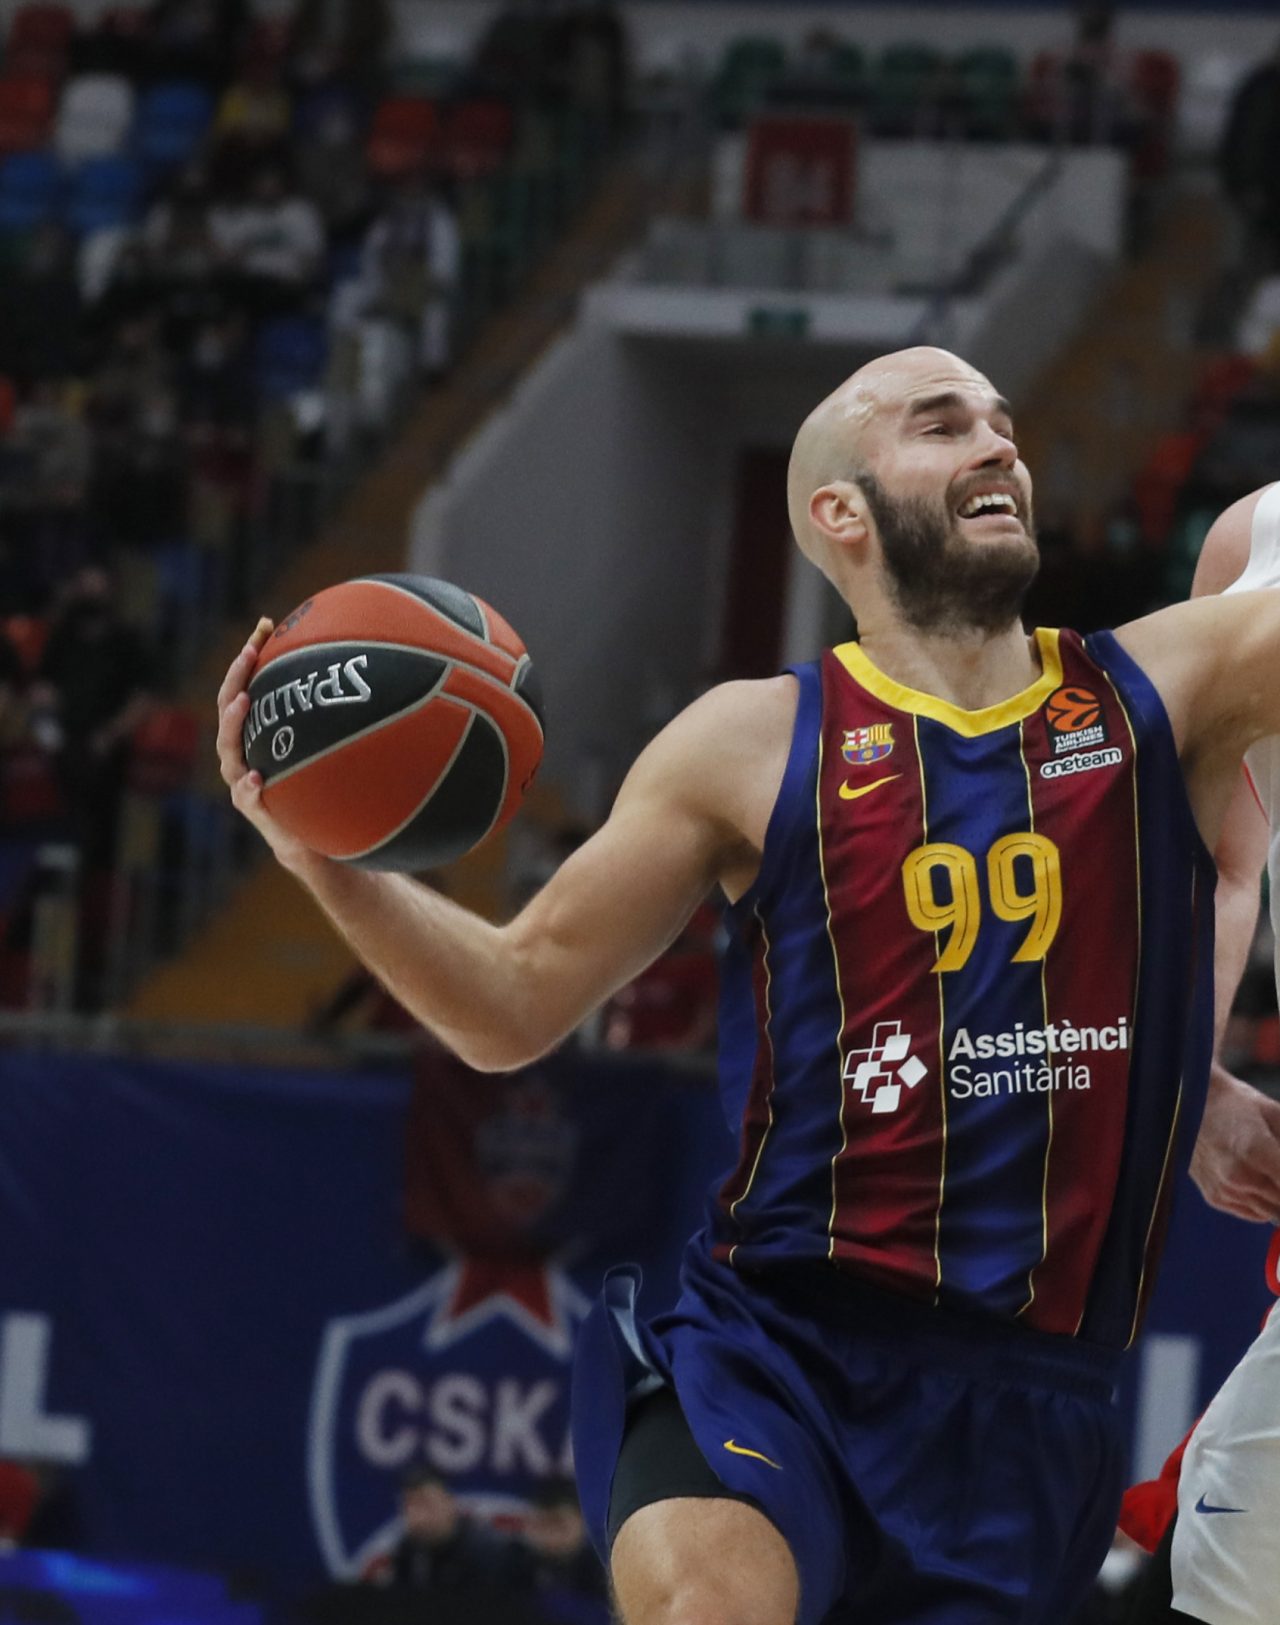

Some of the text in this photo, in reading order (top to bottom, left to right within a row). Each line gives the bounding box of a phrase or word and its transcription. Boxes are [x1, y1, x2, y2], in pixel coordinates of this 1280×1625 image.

[244, 654, 371, 760] SPALDIN
[1054, 725, 1103, 744] TURKISH
[902, 832, 1062, 973] 99
[948, 1017, 1131, 1061] Assistènci
[950, 1057, 1090, 1099] Sanitària
[357, 1368, 573, 1474] CSK
